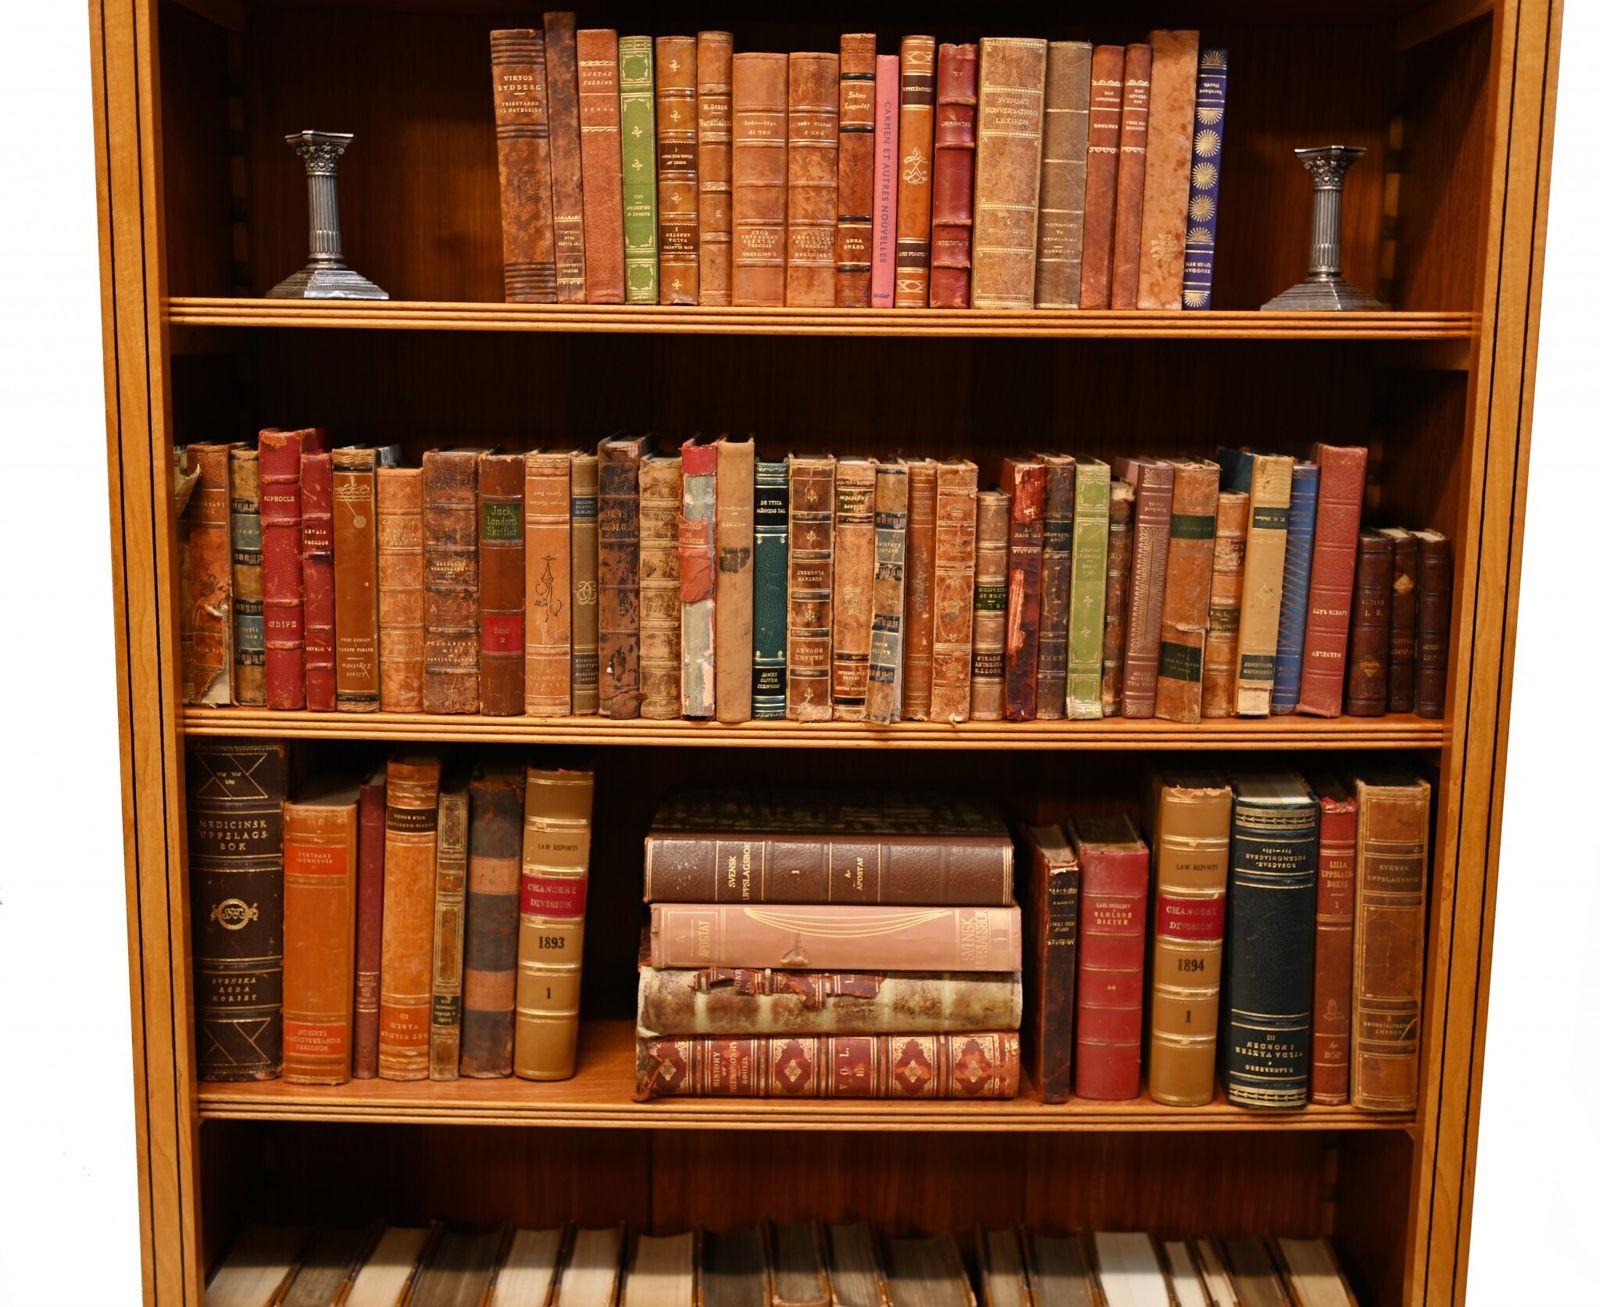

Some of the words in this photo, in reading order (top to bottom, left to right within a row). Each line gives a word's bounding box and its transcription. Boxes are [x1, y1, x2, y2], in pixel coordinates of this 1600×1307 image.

[847, 91, 867, 99] Selma
[997, 97, 1030, 106] SVENSKT
[985, 106, 1040, 117] KONVERSATIONS
[884, 101, 892, 144] CARMEN
[995, 117, 1029, 126] LEXIKON
[883, 148, 891, 160] ET
[881, 163, 891, 201] AUTRES
[880, 205, 889, 264] NOUVELLES
[491, 505, 513, 516] Jack
[487, 526, 518, 536] Skrifter
[199, 820, 267, 829] MEDICINSK
[219, 842, 246, 851] BOK
[1176, 863, 1190, 871] LAW
[1193, 863, 1219, 871] REPORTS
[1329, 860, 1347, 869] LILLA
[728, 855, 738, 889] SVENSK
[742, 842, 753, 901] UPPSLAGSBOK
[856, 856, 865, 892] APOSTAT
[526, 883, 577, 895] CHANCERY
[529, 898, 573, 909] DIVISION
[1093, 911, 1132, 919] SAMLADE
[1165, 905, 1218, 916] CHANCERY
[1096, 918, 1129, 926] DIKTER
[1169, 920, 1214, 931] DIVISION
[538, 936, 566, 950] 1893
[699, 920, 711, 959] APOSTAT
[960, 916, 977, 961] SVENSK
[1177, 958, 1205, 972] 1894
[212, 977, 256, 985] SVENSKA
[212, 994, 256, 1003] KORSET
[546, 987, 552, 1000] 1
[1185, 1010, 1192, 1024] 1
[1246, 1041, 1288, 1051] NORDEN
[1234, 1046, 1273, 1058] VÄXTER
[1274, 1050, 1304, 1058] VILDA
[712, 1051, 722, 1089] HISTORY
[721, 1066, 728, 1077] OF
